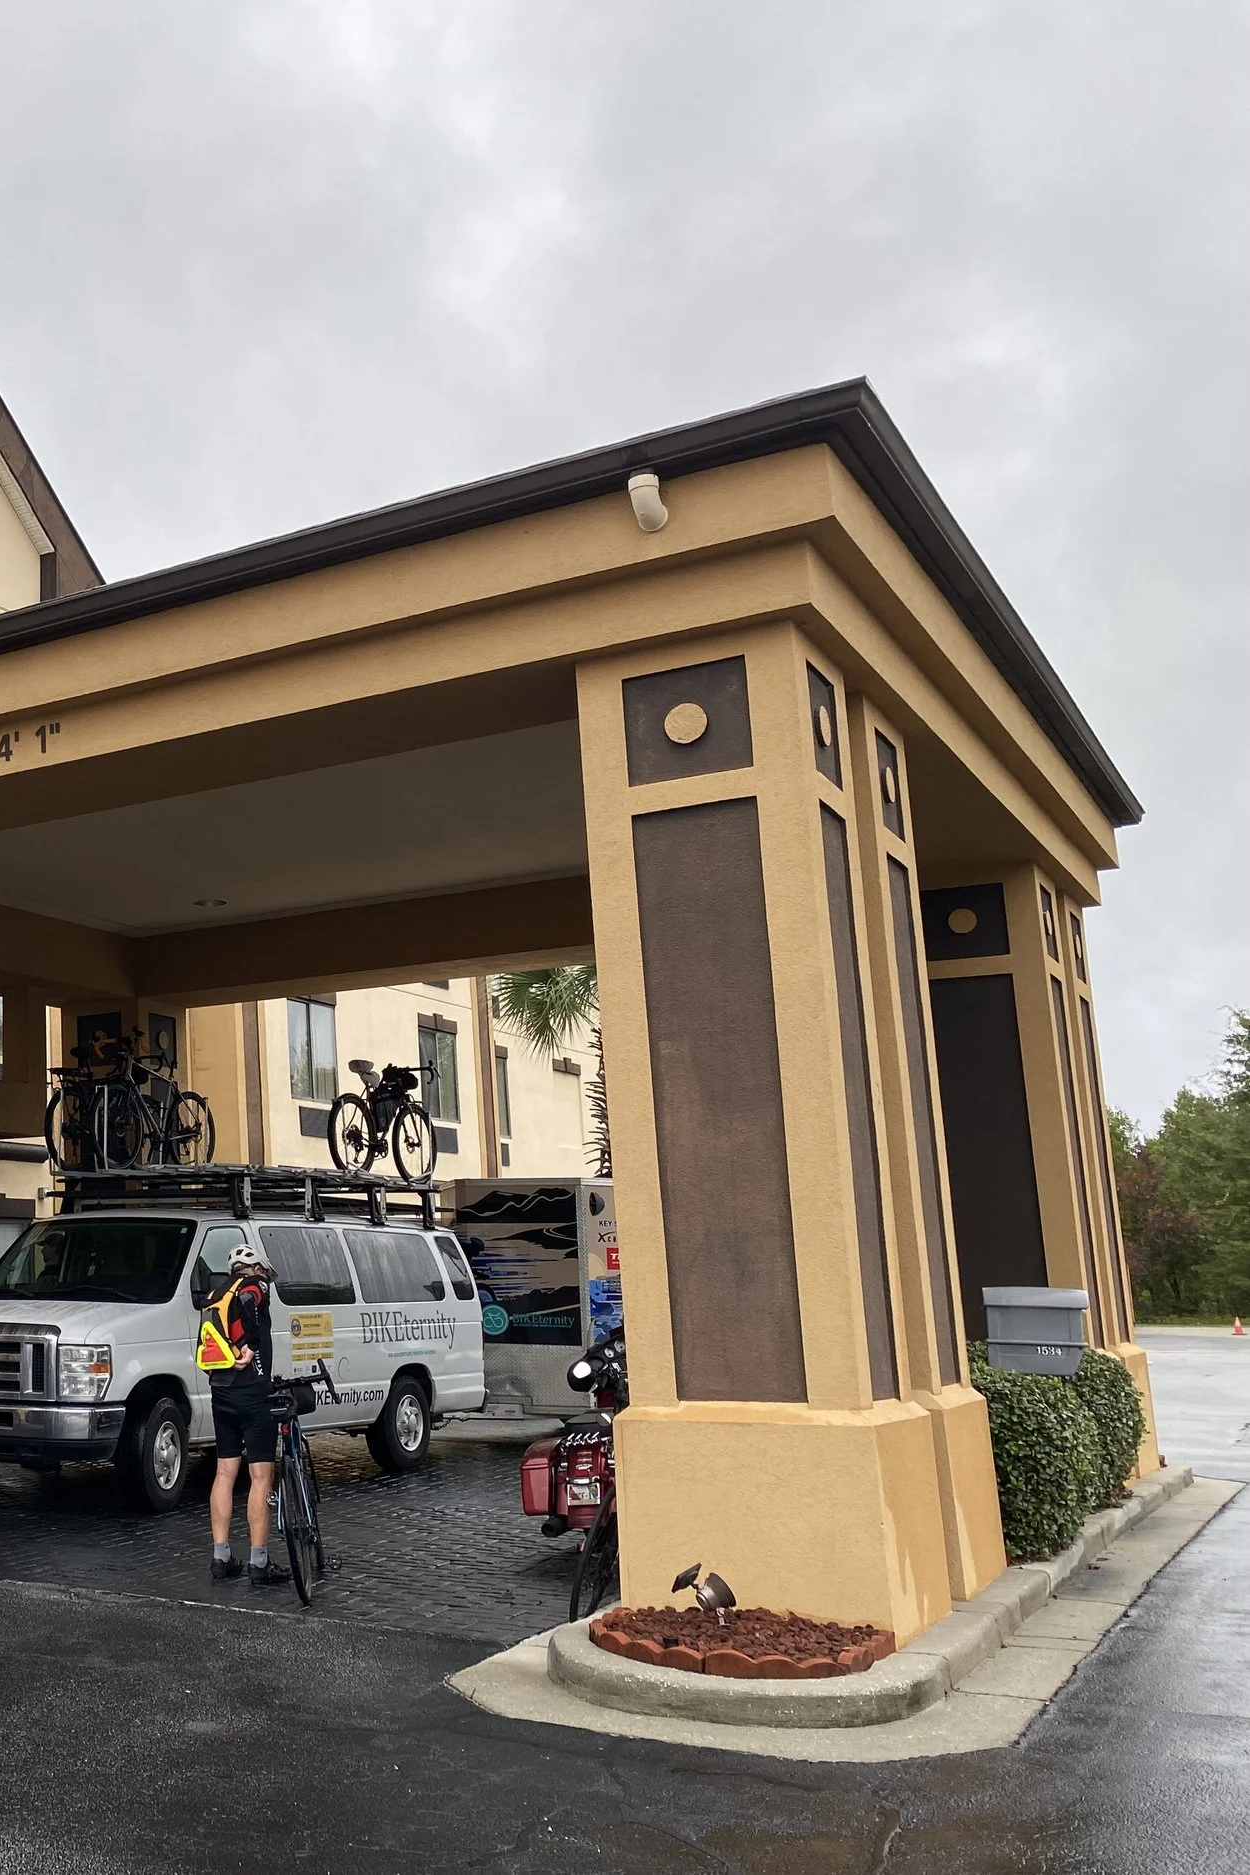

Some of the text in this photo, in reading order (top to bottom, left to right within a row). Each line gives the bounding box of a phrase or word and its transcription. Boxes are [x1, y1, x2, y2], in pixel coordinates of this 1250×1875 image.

[512, 1313, 575, 1328] BIKEternity
[359, 1310, 456, 1349] BIKEternity
[1036, 1346, 1062, 1356] 1534
